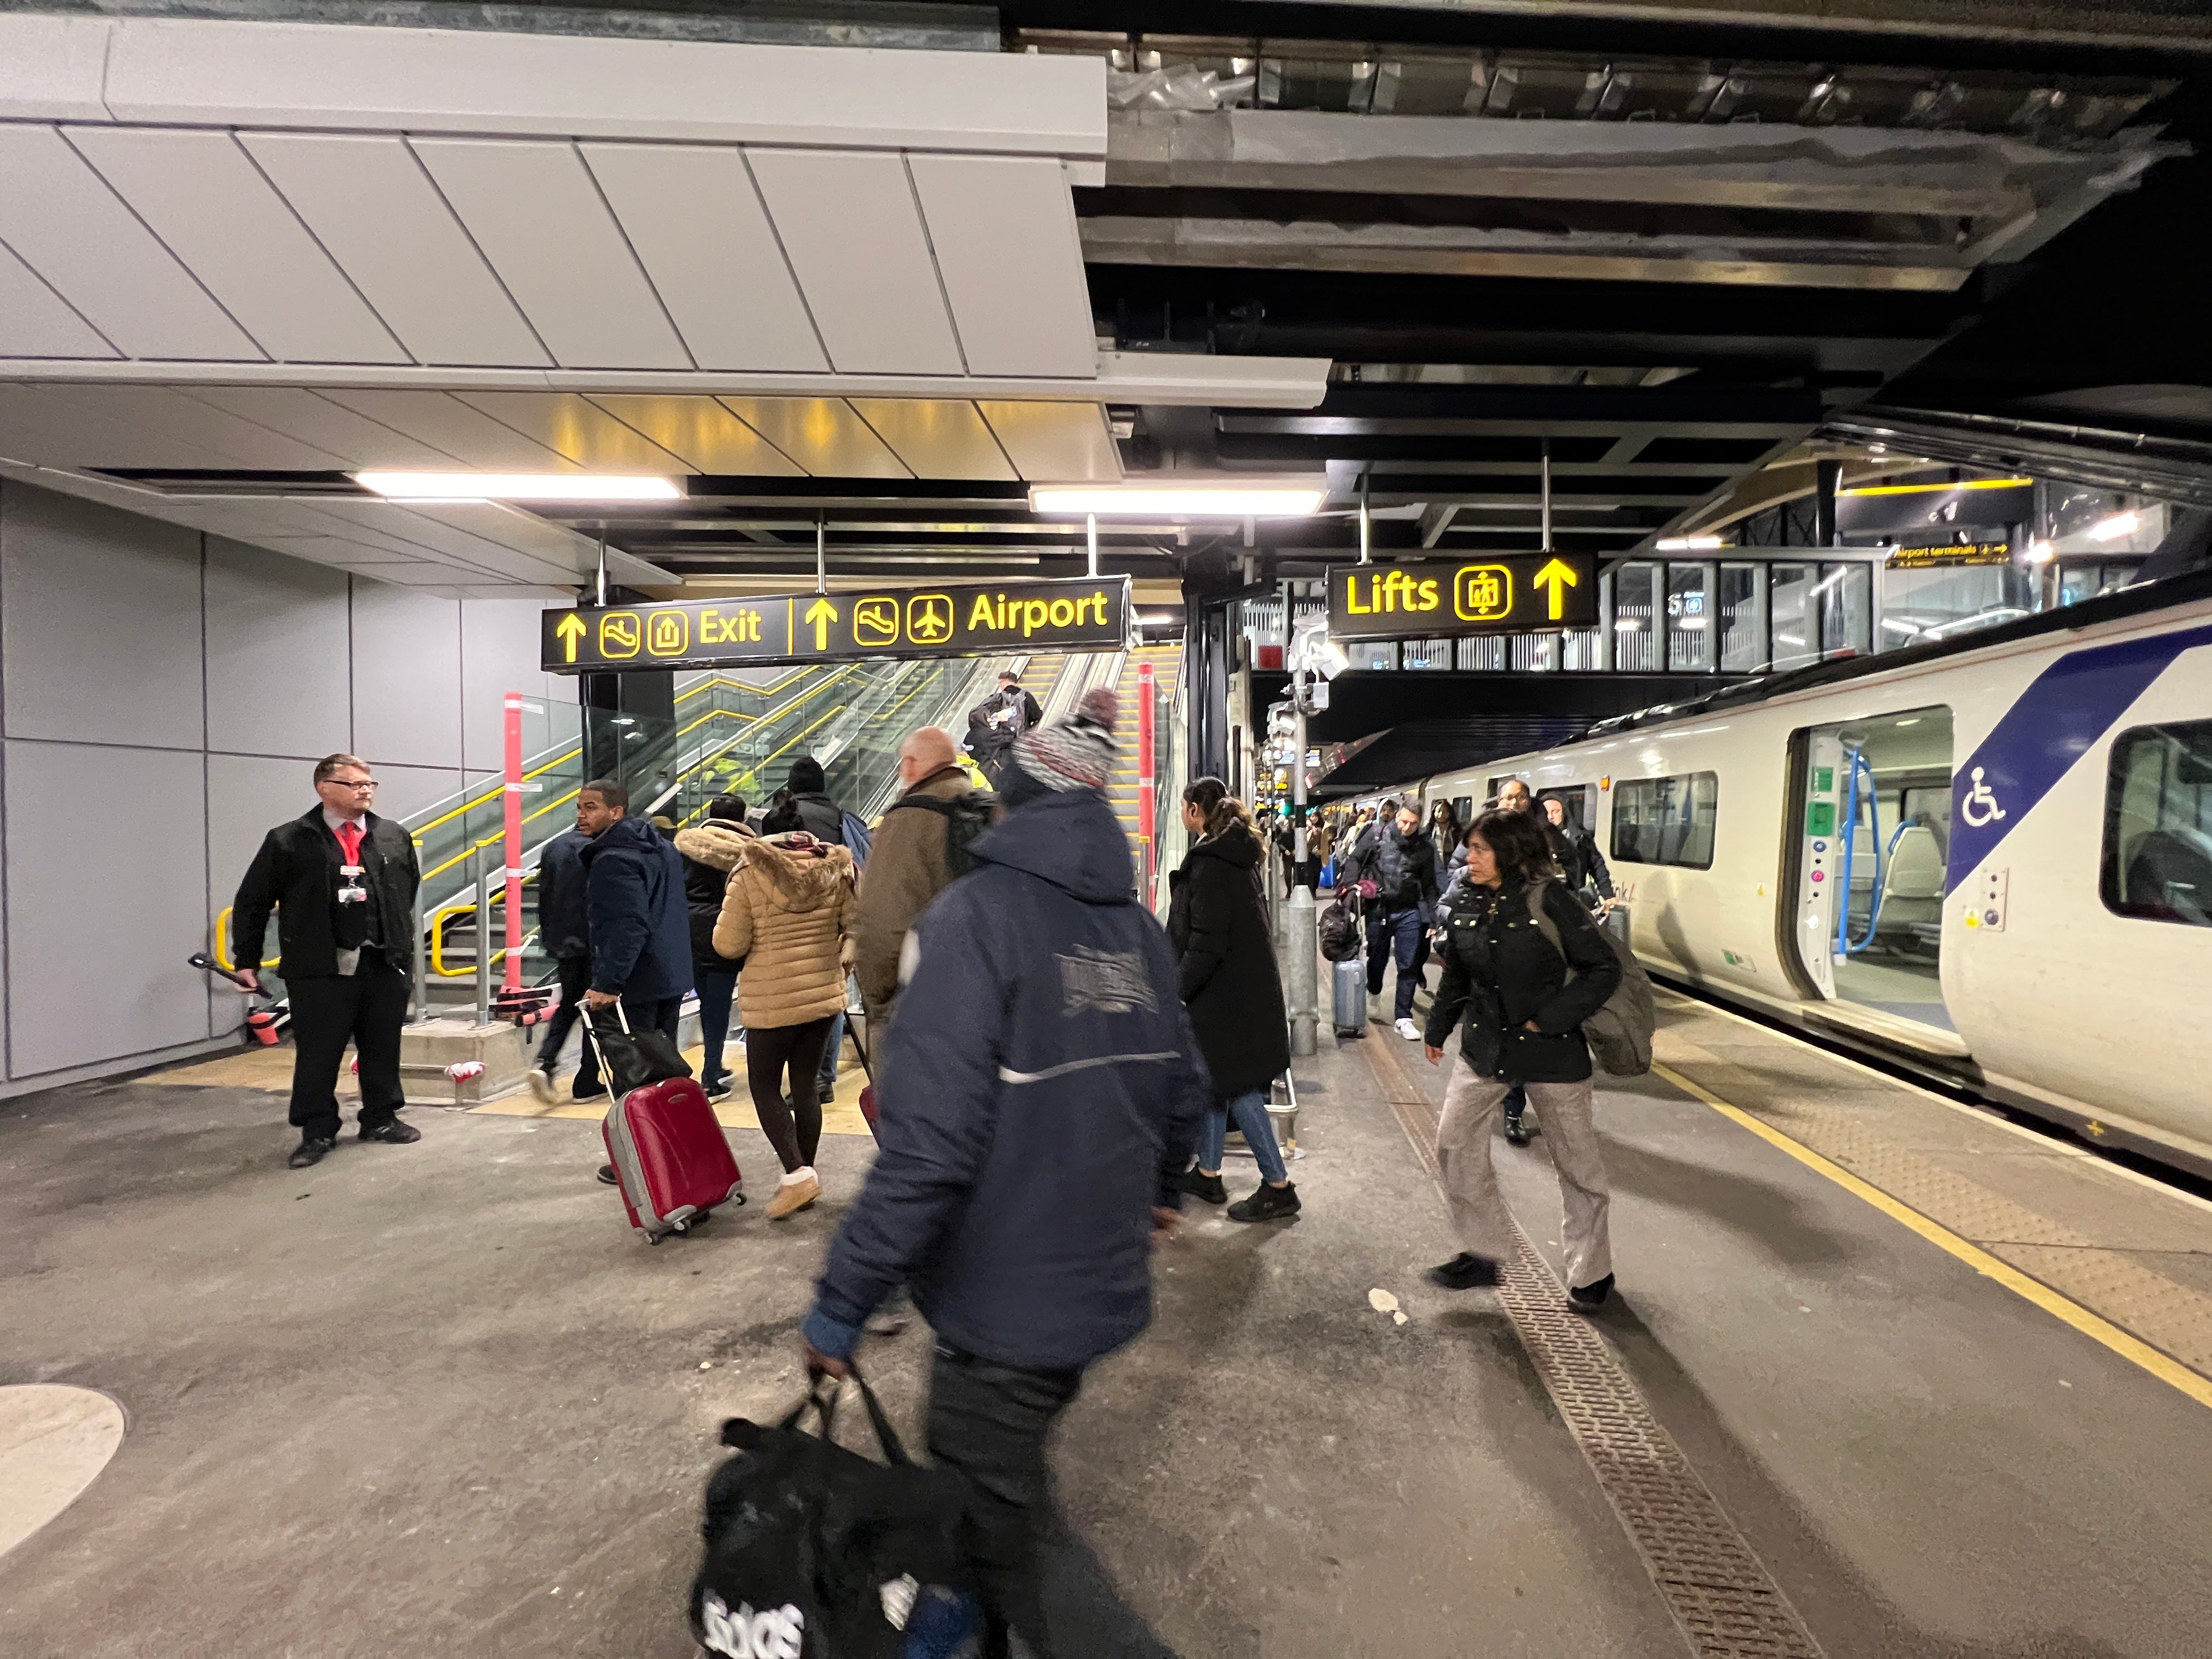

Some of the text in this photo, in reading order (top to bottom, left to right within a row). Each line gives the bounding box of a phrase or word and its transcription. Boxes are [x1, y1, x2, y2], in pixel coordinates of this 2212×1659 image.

[1894, 545, 1977, 558] Airport terminals
[1347, 571, 1438, 614] Lifts
[700, 608, 762, 644] Exit
[968, 591, 1108, 637] Airport
